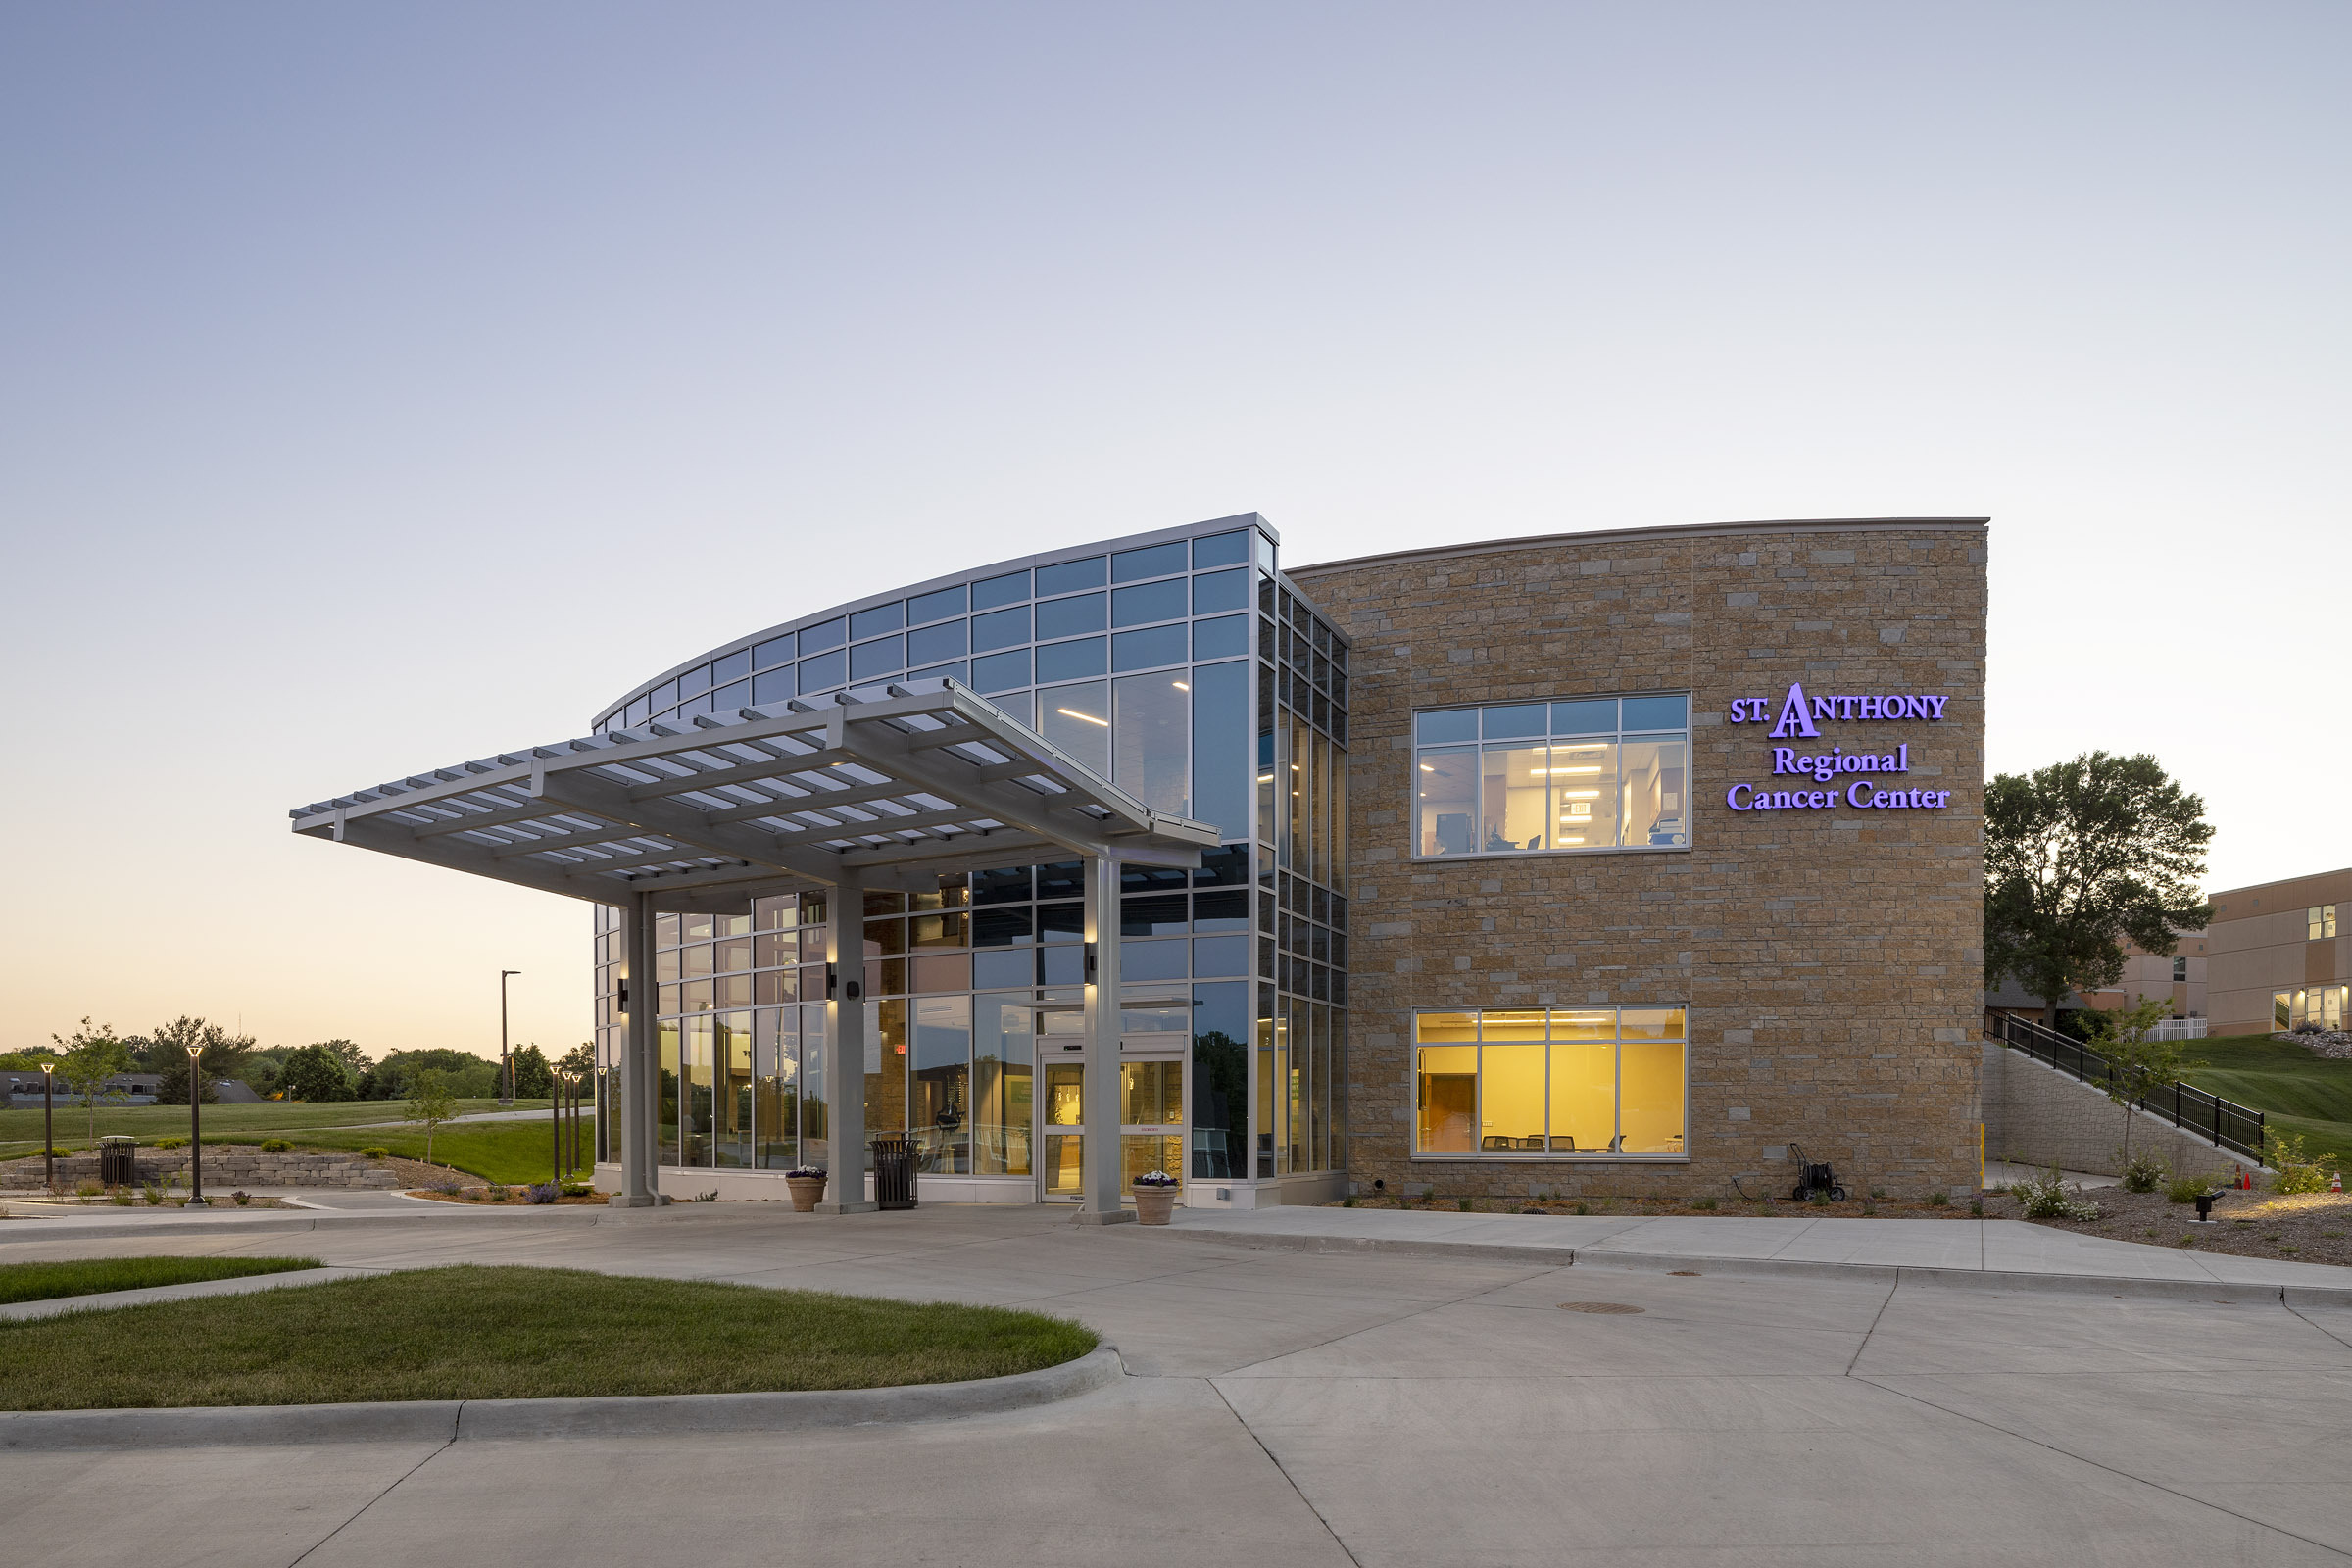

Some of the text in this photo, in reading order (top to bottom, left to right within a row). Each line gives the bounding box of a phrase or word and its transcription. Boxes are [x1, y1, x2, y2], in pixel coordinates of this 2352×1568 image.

[1730, 681, 1949, 738] ST. ANTHONY
[1772, 743, 1909, 782] Regional
[1727, 781, 1950, 811] Cancer Center
